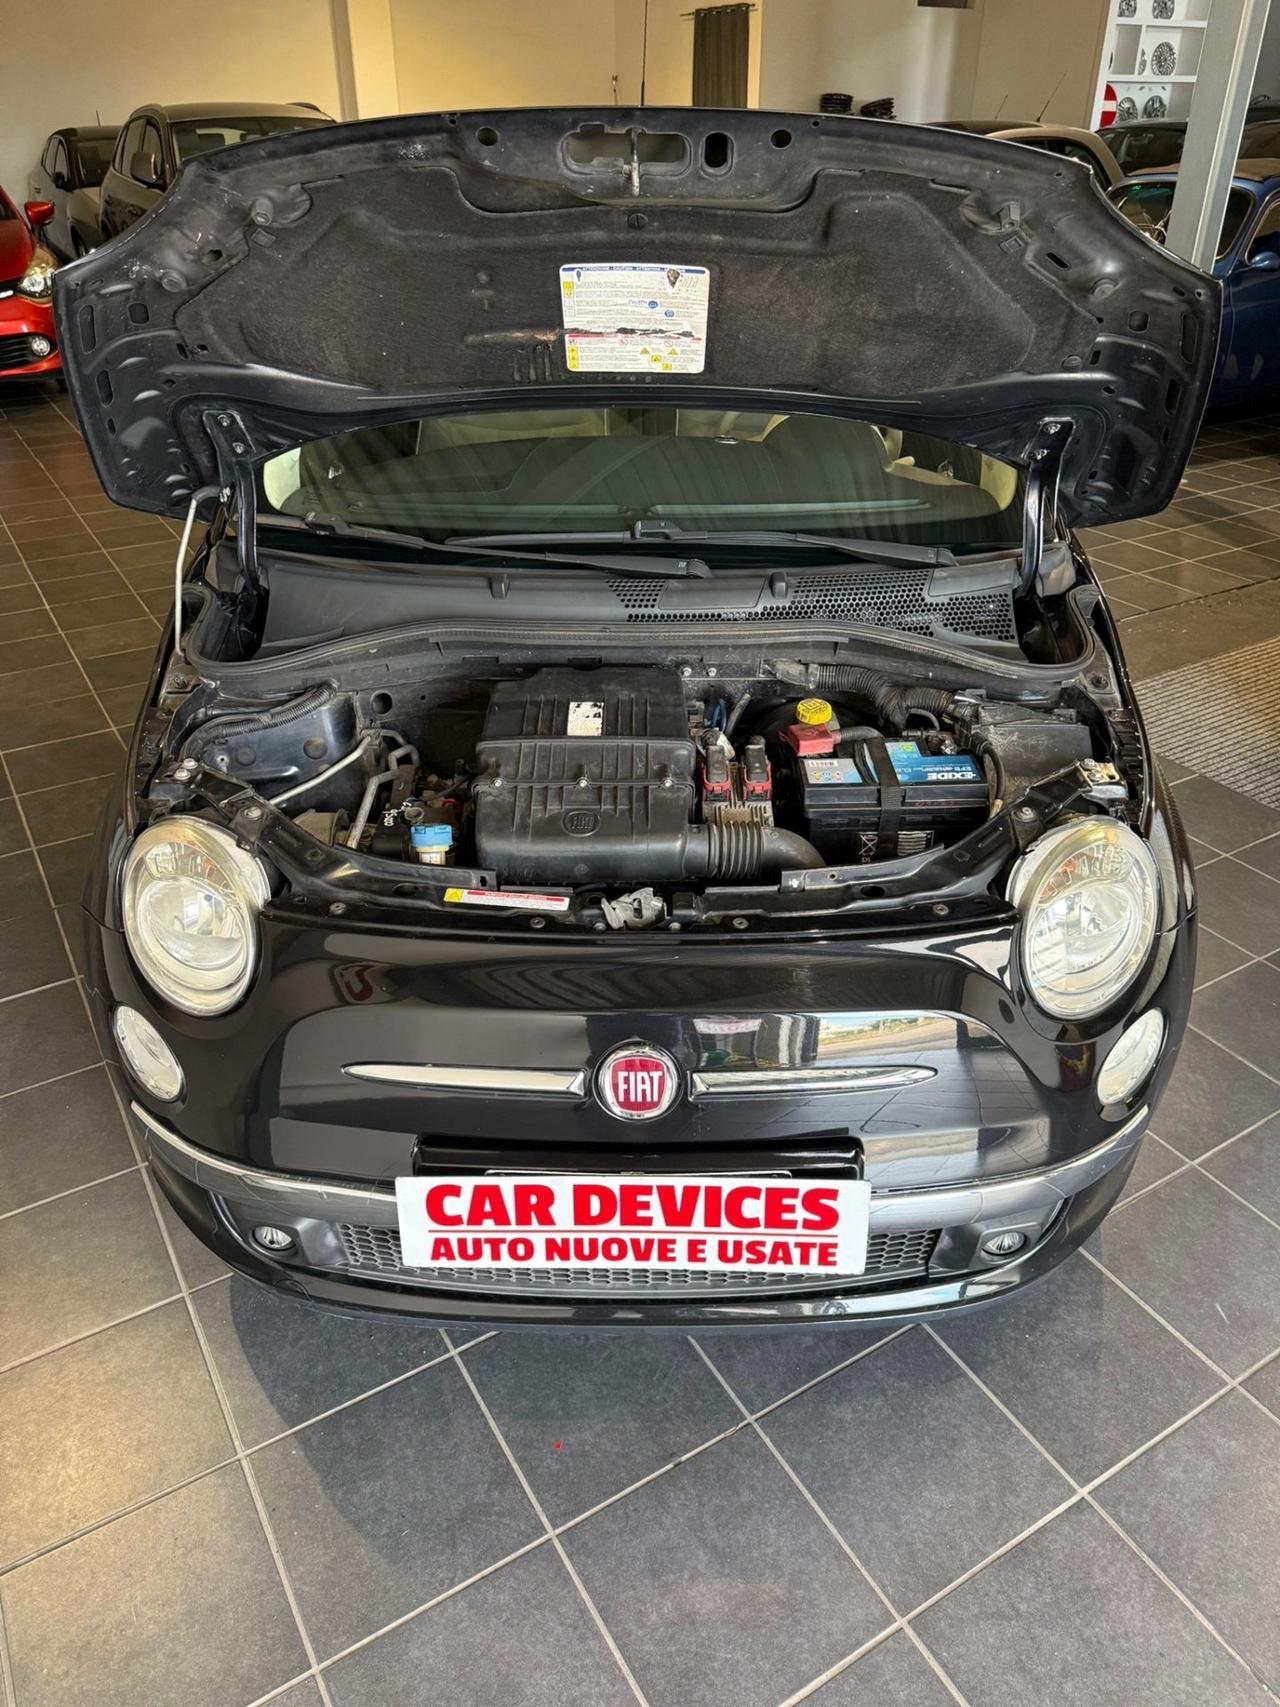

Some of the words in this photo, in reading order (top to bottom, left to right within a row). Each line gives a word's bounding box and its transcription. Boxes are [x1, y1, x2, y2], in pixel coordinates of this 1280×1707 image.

[927, 771, 977, 781] EXIDE
[617, 1070, 663, 1102] FIAT
[426, 1184, 555, 1227] CAR
[572, 1184, 840, 1231] DEVICES
[431, 1237, 535, 1262] AUTO
[545, 1237, 676, 1263] NUOVE
[687, 1239, 707, 1263] E
[718, 1240, 838, 1267] USATE
